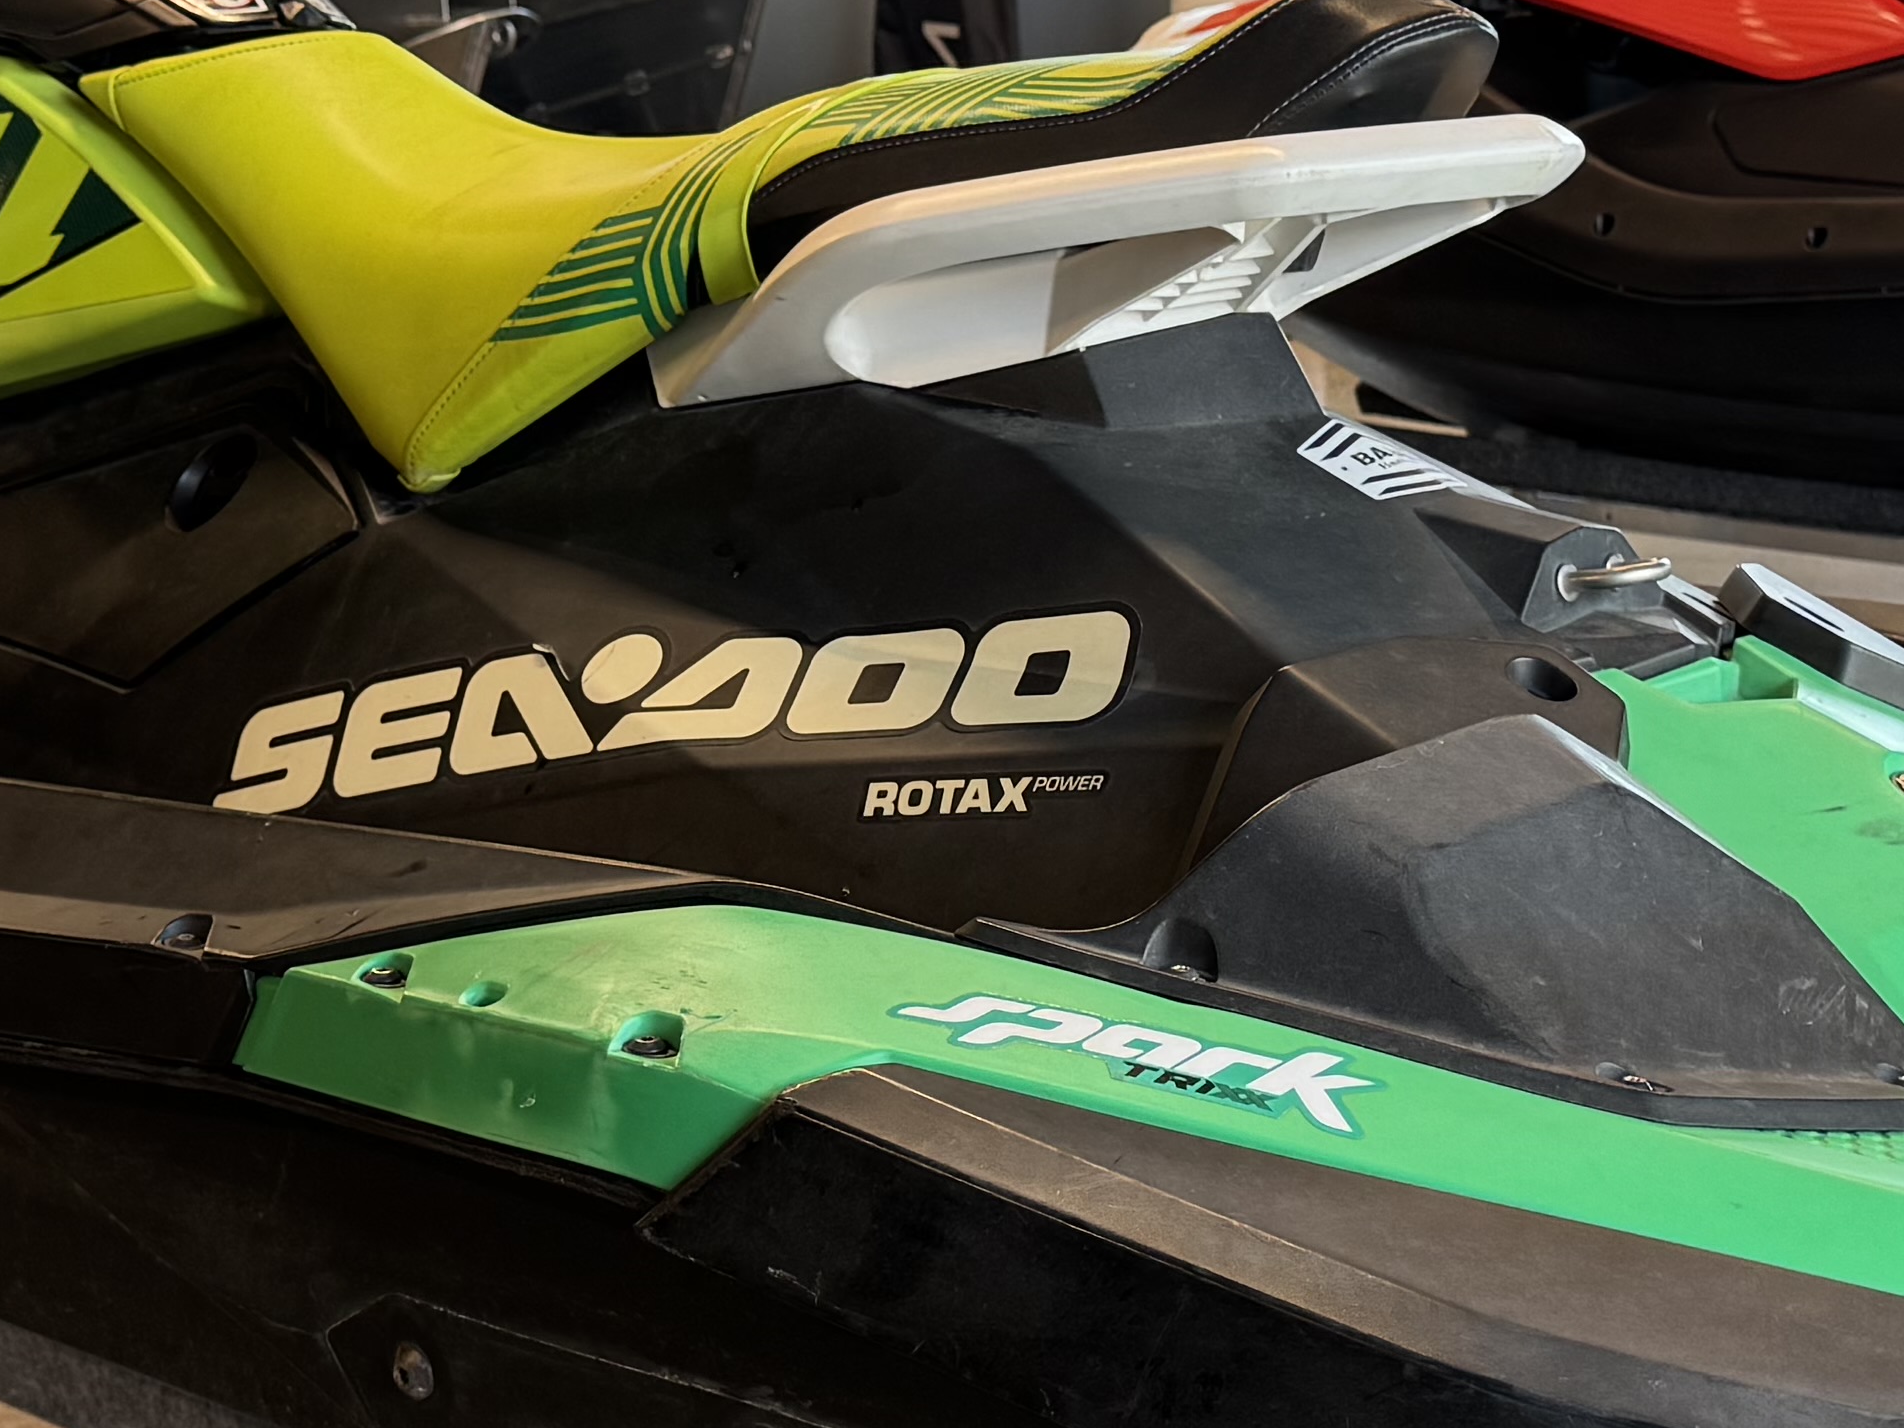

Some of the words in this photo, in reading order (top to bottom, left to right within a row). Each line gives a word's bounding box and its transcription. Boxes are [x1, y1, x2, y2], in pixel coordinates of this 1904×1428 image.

[862, 776, 1034, 817] ROTAX
[1032, 774, 1105, 793] POWER
[1123, 1060, 1277, 1113] TRIXX
